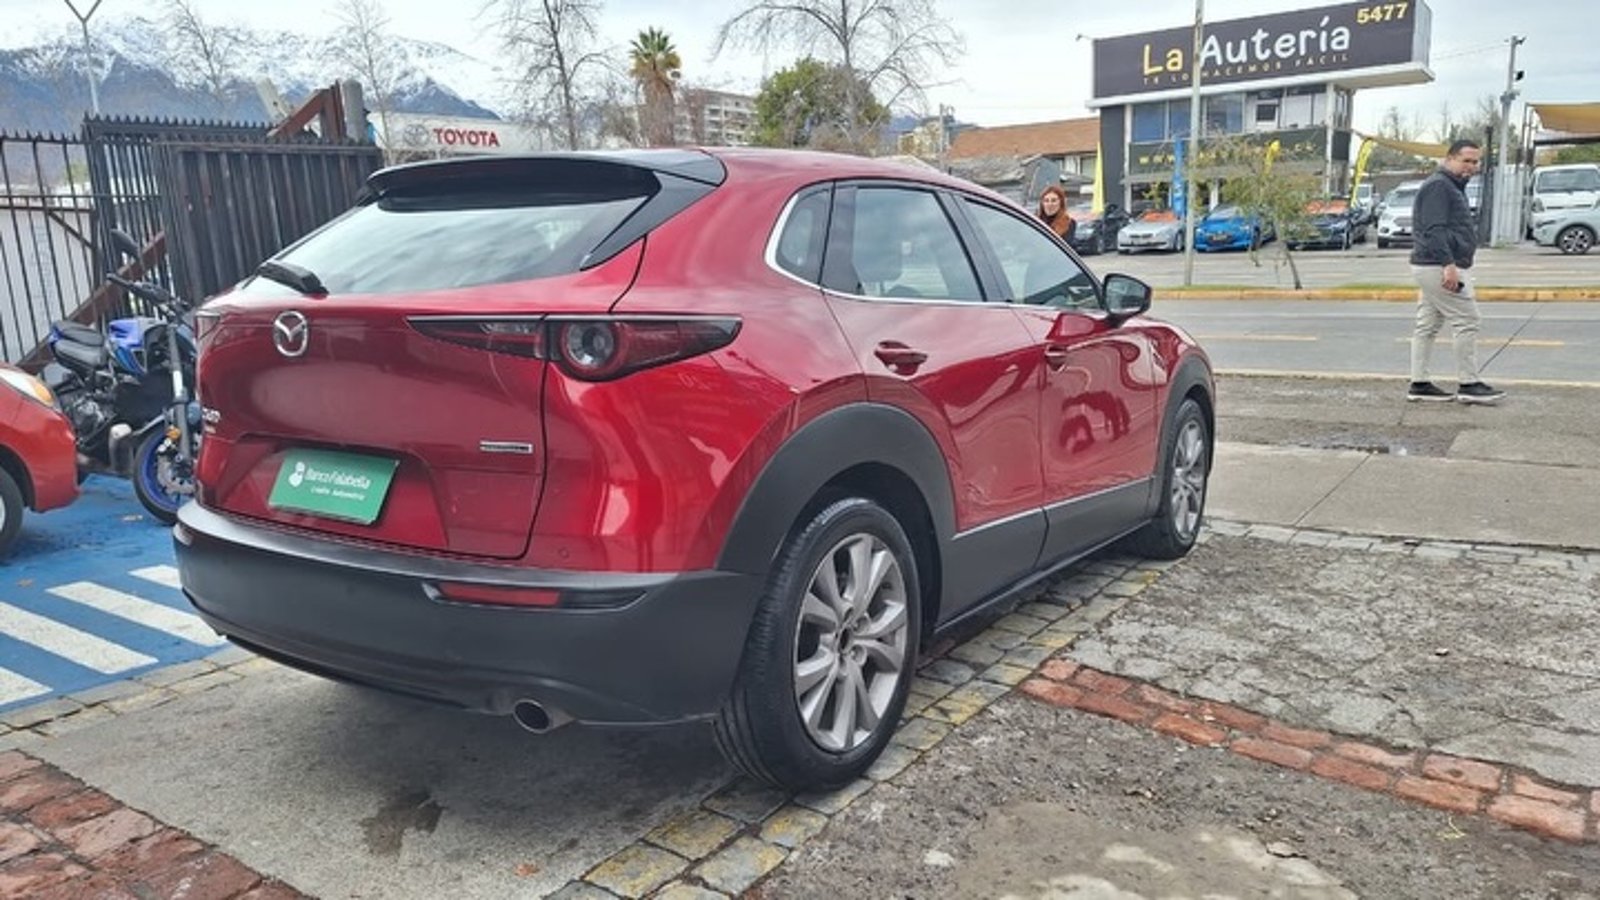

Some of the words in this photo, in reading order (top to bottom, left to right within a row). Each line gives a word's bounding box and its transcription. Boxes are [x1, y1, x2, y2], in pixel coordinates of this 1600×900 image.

[1357, 3, 1407, 24] 5477
[1143, 43, 1184, 75] La
[1200, 15, 1350, 68] Autería
[433, 128, 499, 147] TOYOTA
